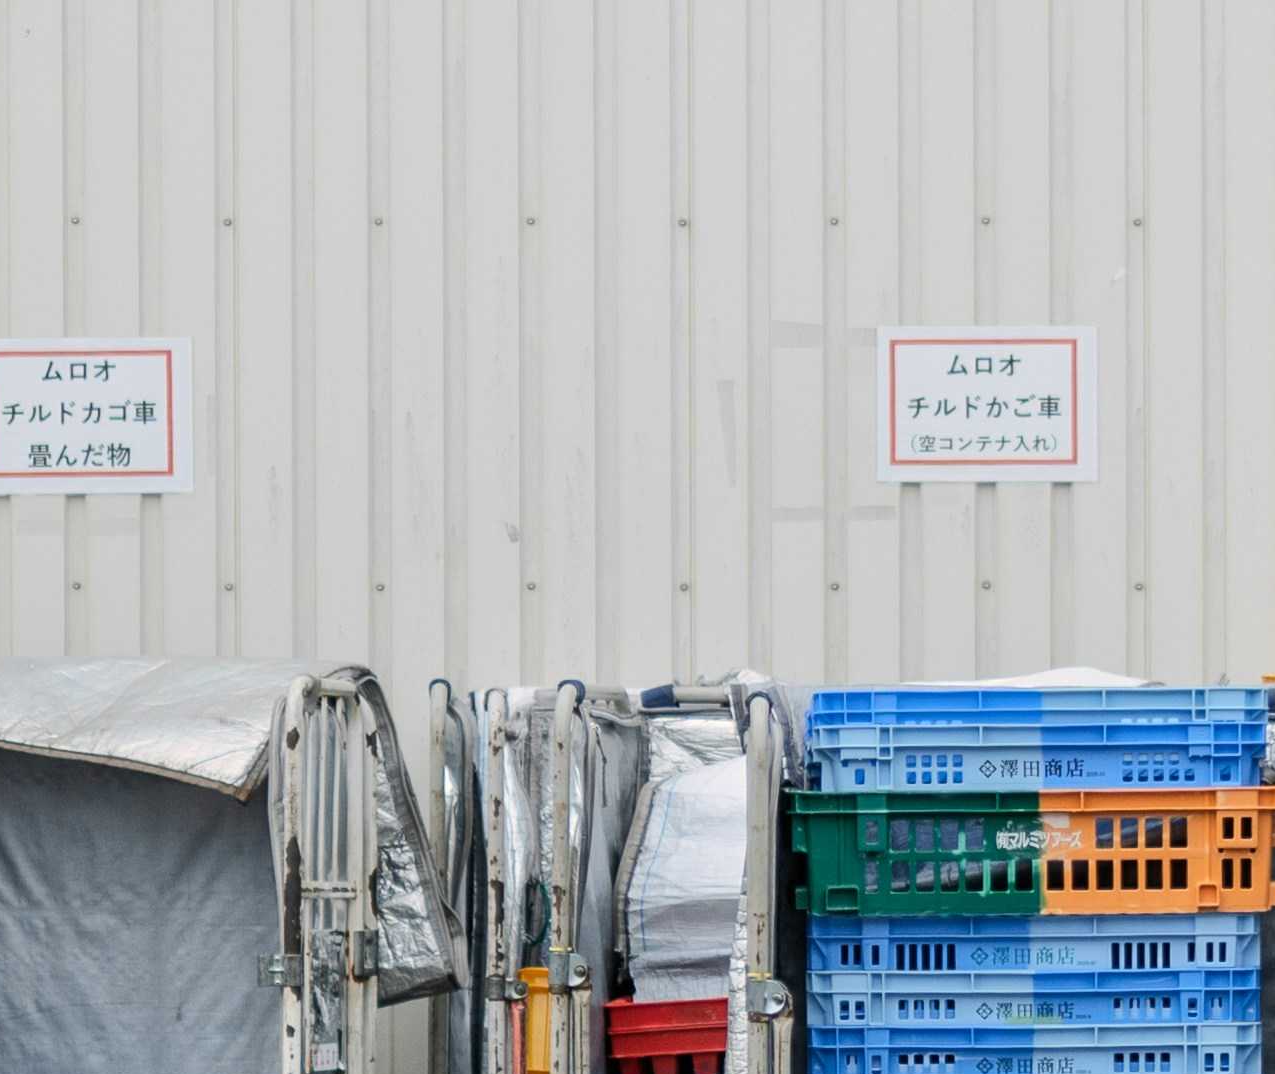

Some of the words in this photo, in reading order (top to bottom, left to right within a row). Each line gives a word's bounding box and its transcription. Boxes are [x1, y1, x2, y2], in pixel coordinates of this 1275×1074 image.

[42, 361, 116, 382] ムロオ
[947, 354, 1021, 376] ムロオ
[2, 400, 157, 425] チルドカゴ車
[908, 394, 1062, 419] チルドかご車
[28, 443, 131, 468] 畳んだ物
[1000, 758, 1084, 778] 澤田商店
